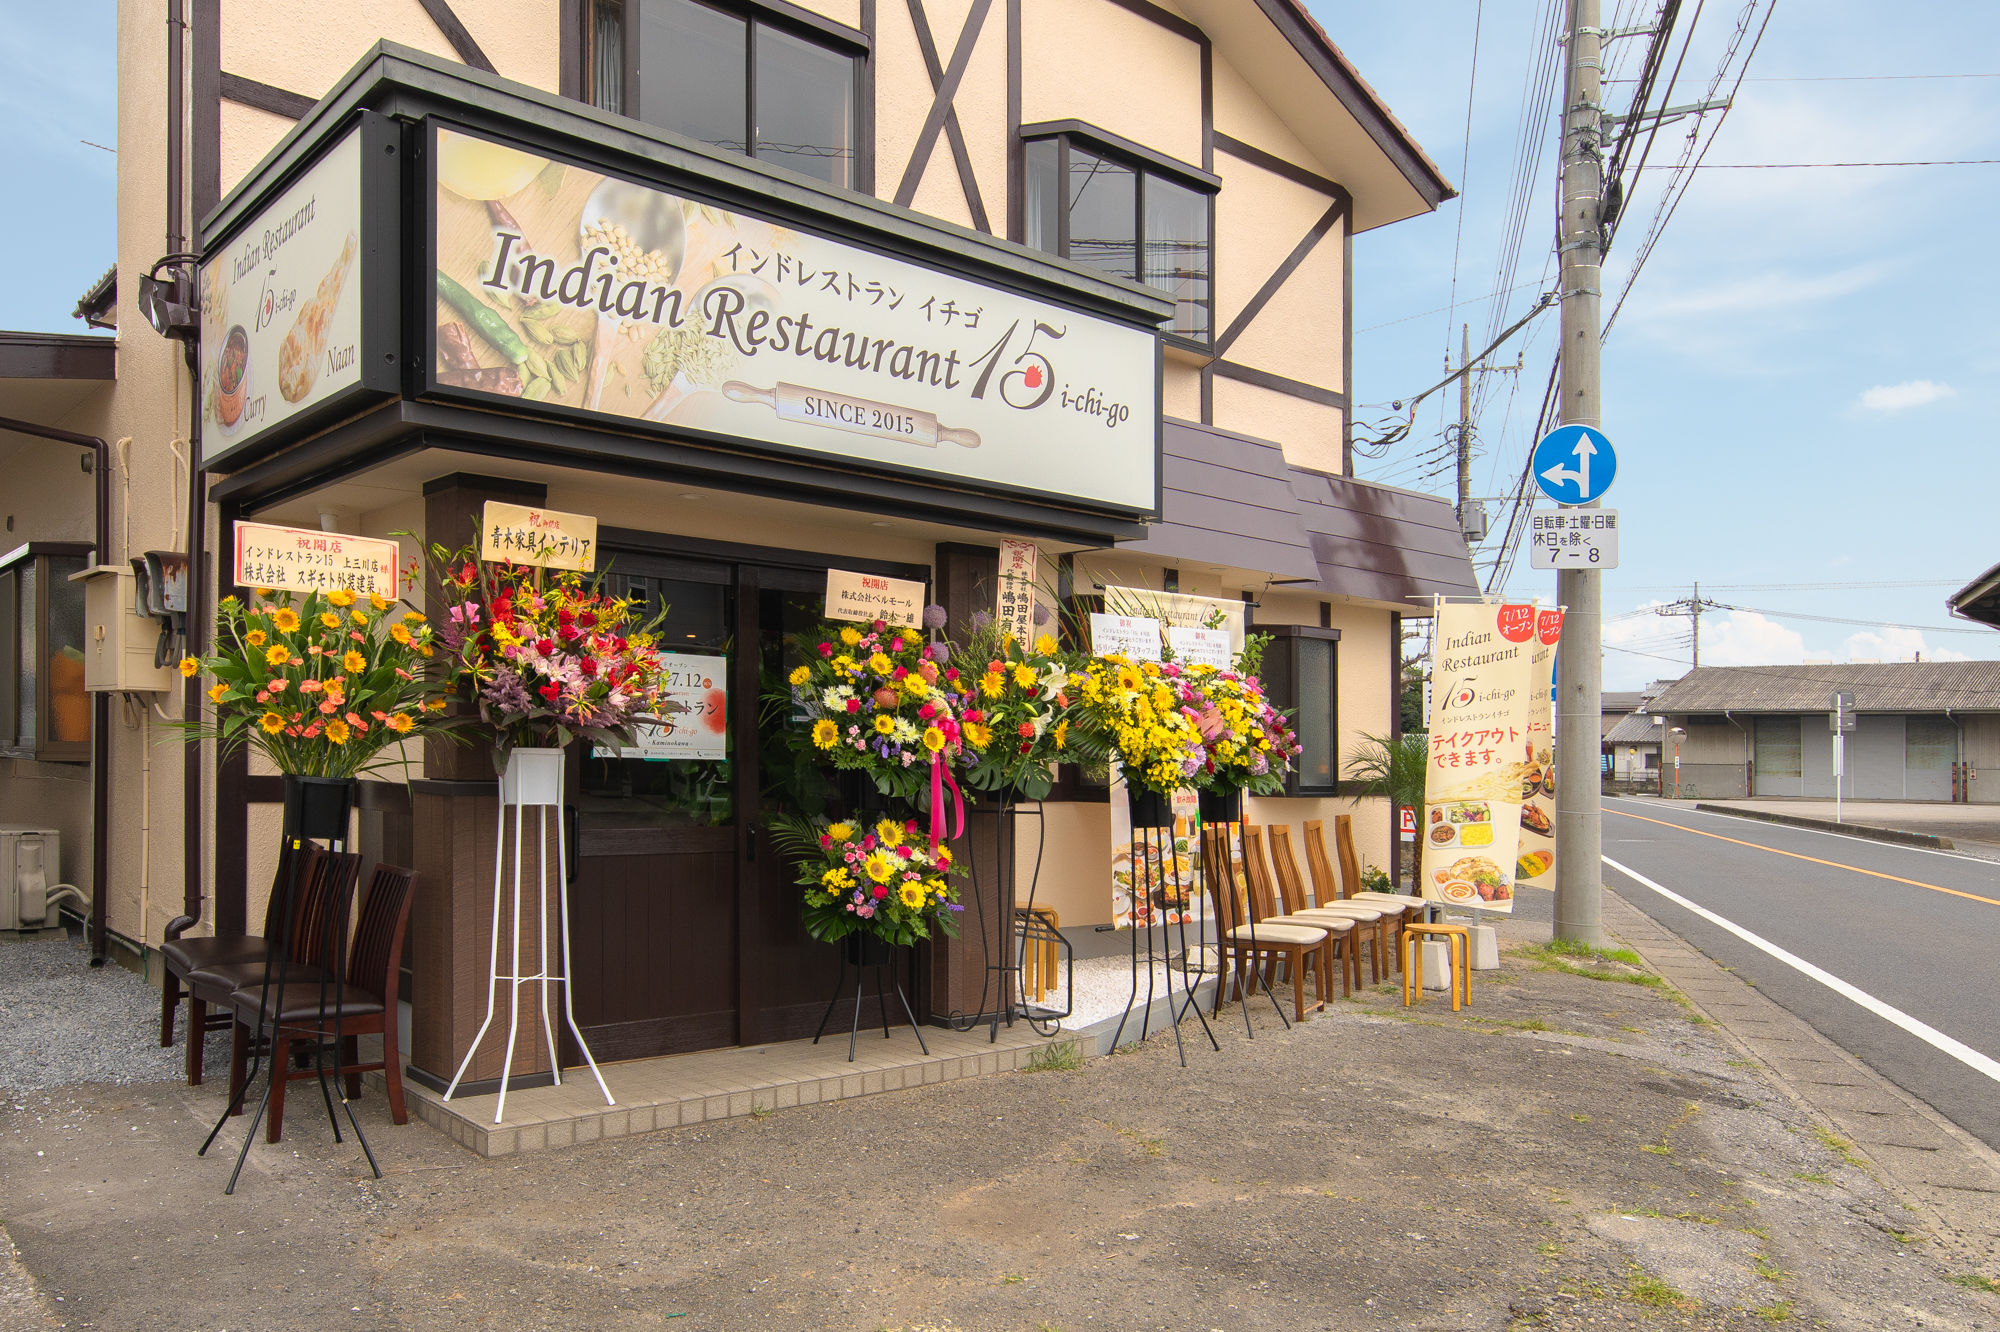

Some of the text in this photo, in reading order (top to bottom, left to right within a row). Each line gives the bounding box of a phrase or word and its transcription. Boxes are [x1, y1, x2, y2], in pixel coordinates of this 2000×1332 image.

[232, 194, 316, 285] Indian Restaurant
[255, 264, 297, 332] 15 i-chi-go
[721, 241, 984, 331] インドレストラン イチゴ
[482, 231, 1131, 428] Indian Restaurant 15 i-chi-go
[326, 342, 355, 378] Naan
[243, 393, 268, 423] Curry
[803, 394, 915, 436] SINCE 2015
[1533, 515, 1616, 529] 自転車・土曜・日曜
[296, 537, 342, 553] 祝開店
[491, 525, 591, 557] 青木家具インテリア
[1532, 531, 1591, 546] 休日を除く
[245, 546, 389, 574] インドレストラン15 上三川店 様
[1012, 549, 1024, 569] 祝開店
[244, 562, 376, 594] 株式会社 スギモト外装建築
[862, 577, 889, 591] 祝開店
[841, 590, 913, 608] 株式会社ベルモール
[1502, 620, 1534, 635] オープン
[1503, 608, 1529, 622] 7/12
[1540, 614, 1560, 625] 7/12
[1446, 631, 1491, 651] Indian
[1539, 624, 1562, 638] オープン
[1442, 646, 1520, 672] Restaurant
[1440, 675, 1478, 711] 15
[1479, 688, 1515, 702] i-chi-go
[1432, 726, 1520, 751] テイクアウト
[1434, 748, 1502, 769] できます。
